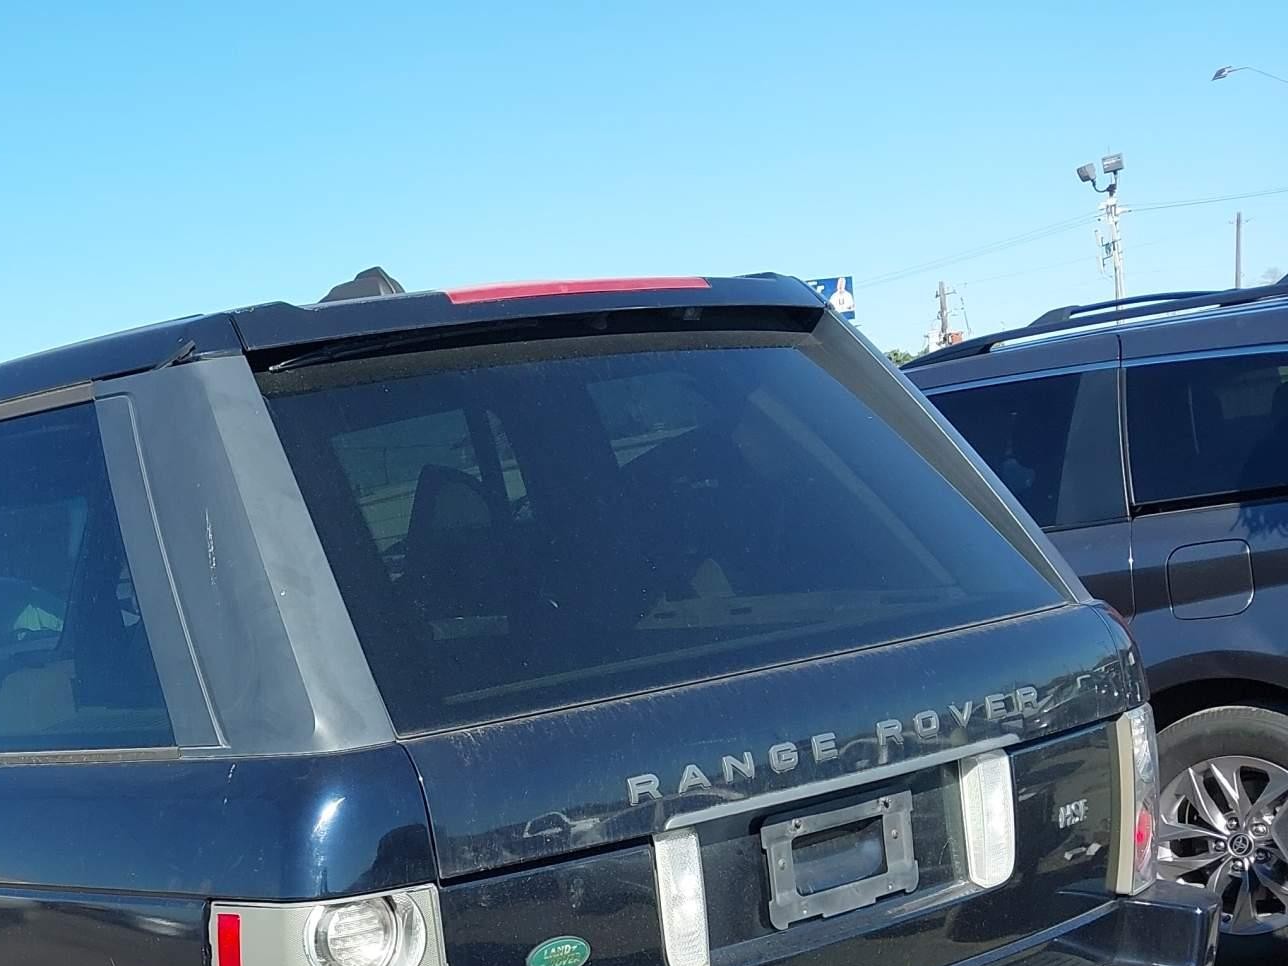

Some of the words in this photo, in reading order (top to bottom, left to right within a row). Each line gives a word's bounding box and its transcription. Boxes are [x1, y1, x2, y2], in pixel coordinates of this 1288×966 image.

[626, 732, 840, 806] RANGE
[876, 685, 1045, 746] ROVER
[543, 943, 572, 959] LAND
